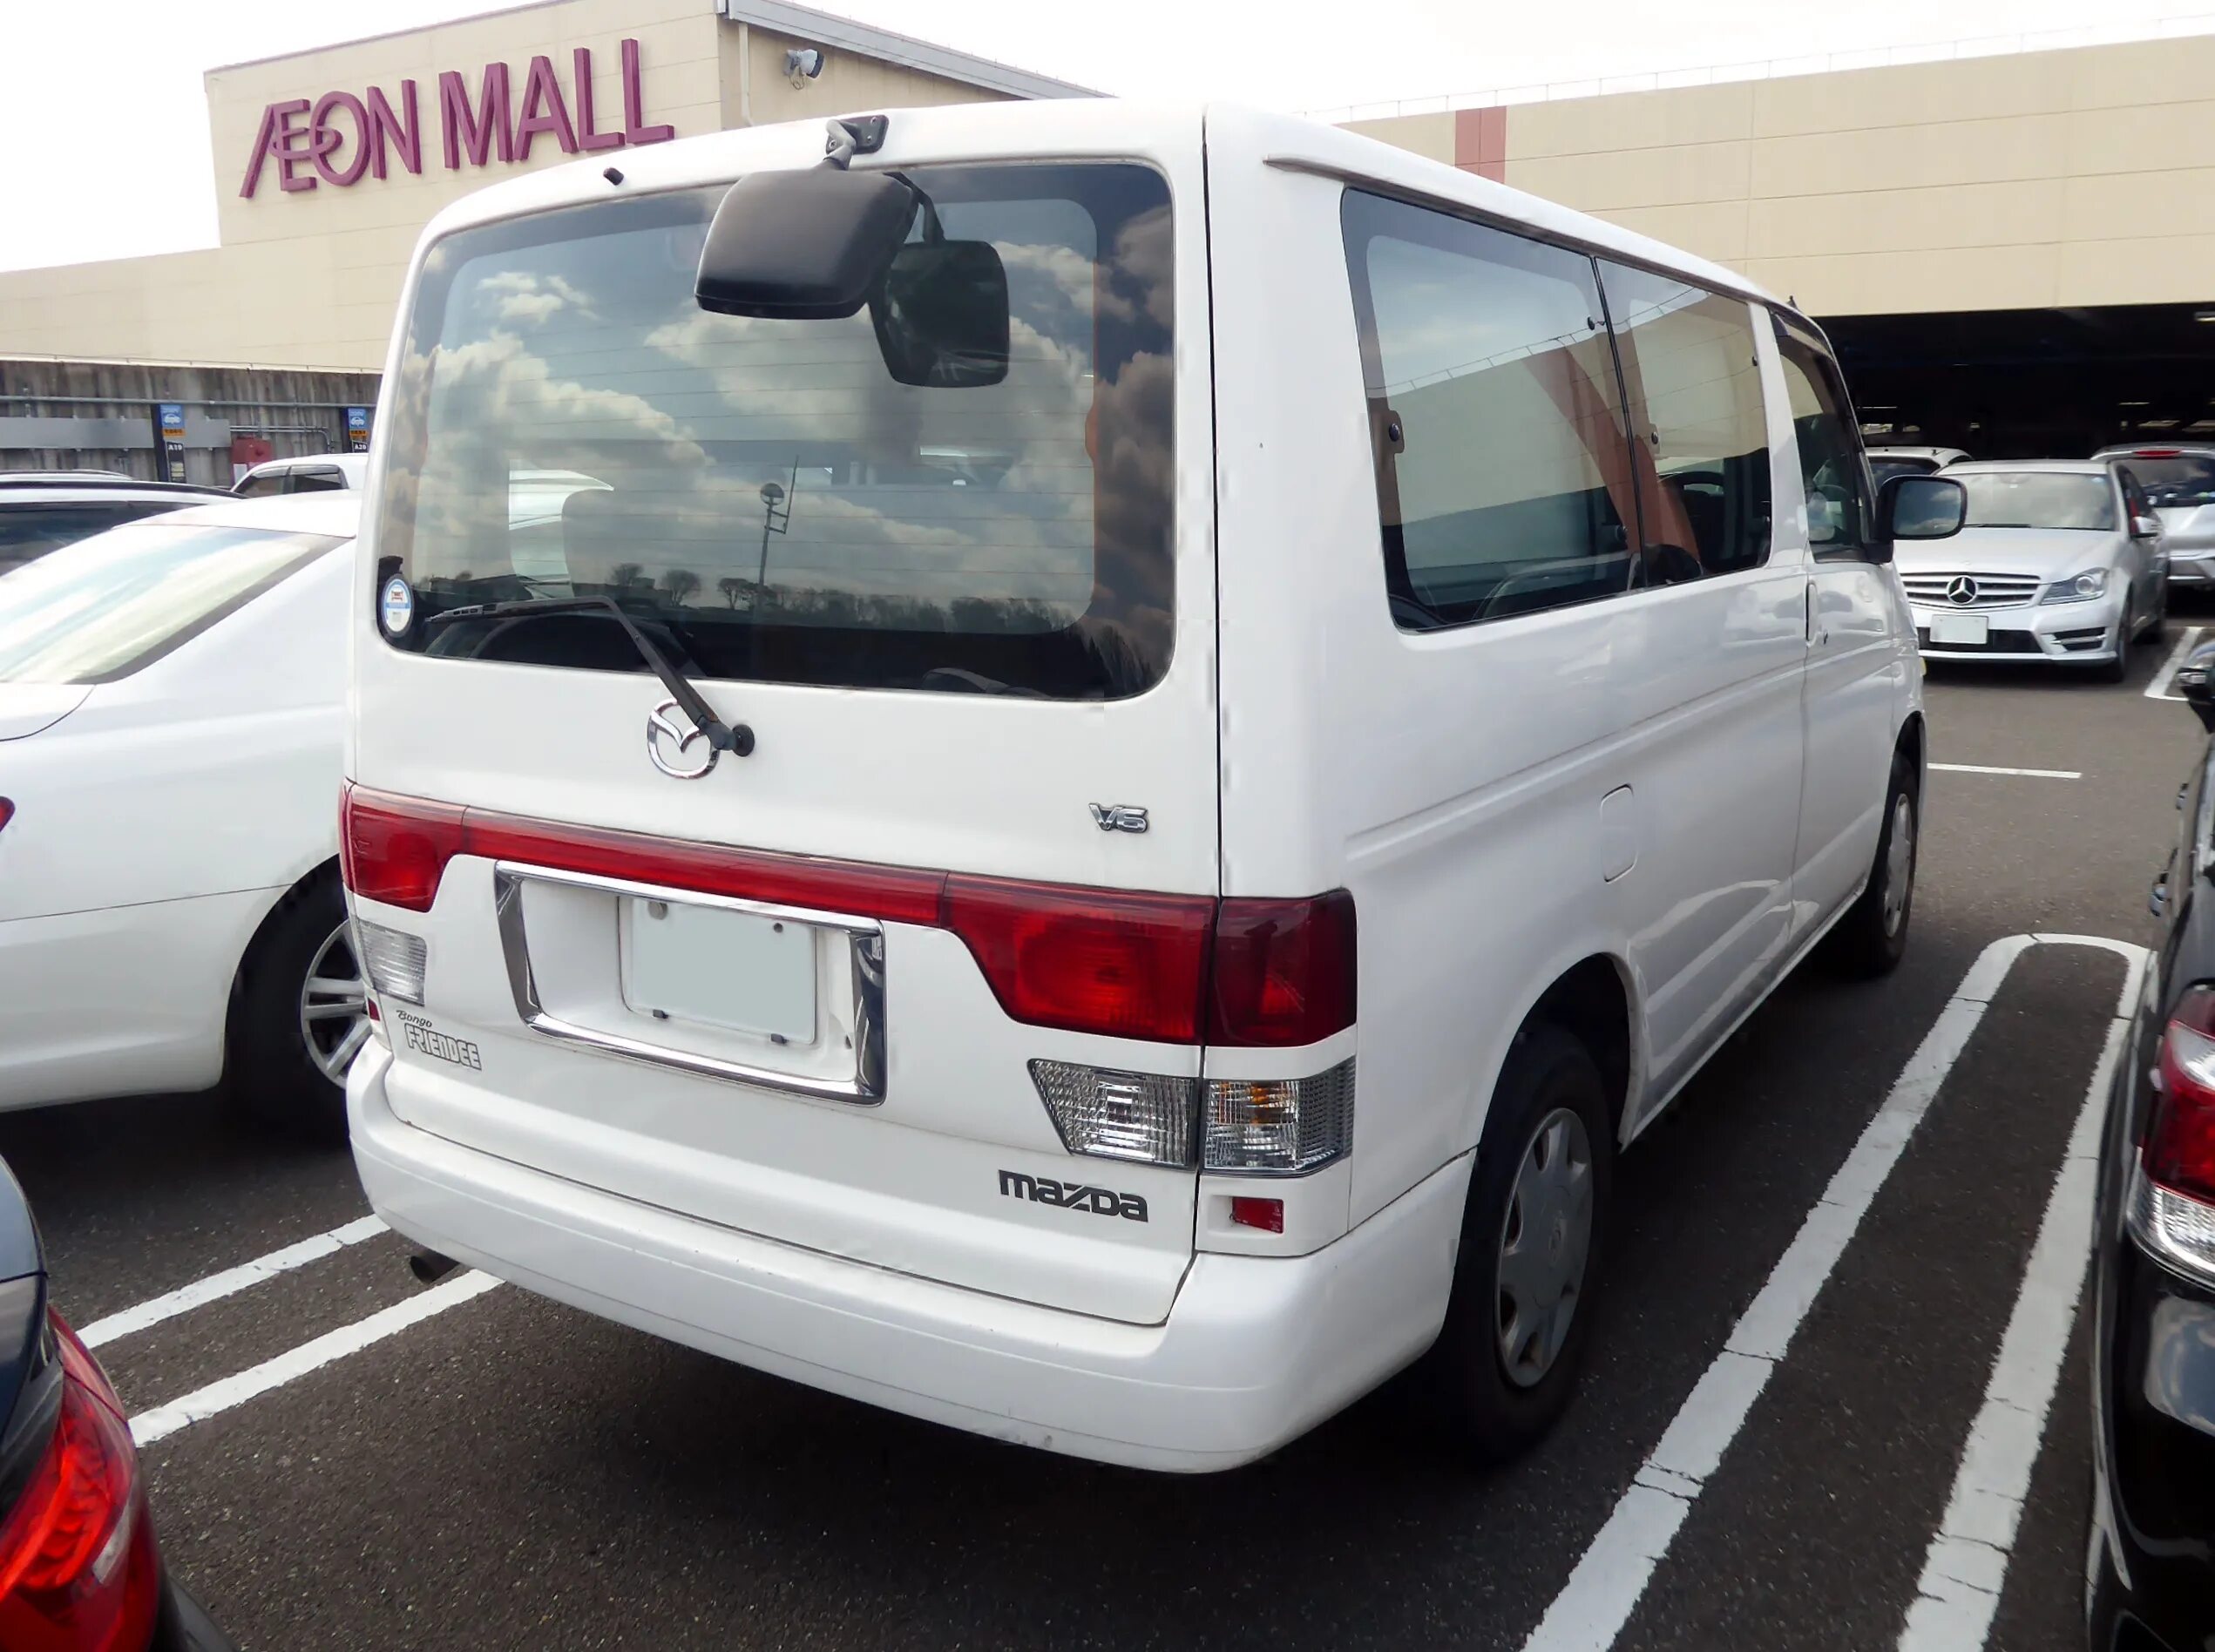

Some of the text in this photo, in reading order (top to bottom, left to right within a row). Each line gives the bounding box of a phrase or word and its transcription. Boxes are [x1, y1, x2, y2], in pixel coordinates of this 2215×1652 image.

[438, 38, 674, 171] MALL
[1088, 802, 1149, 833] V6
[396, 1010, 433, 1028] Bongo
[404, 1023, 482, 1071] FRIENDEE
